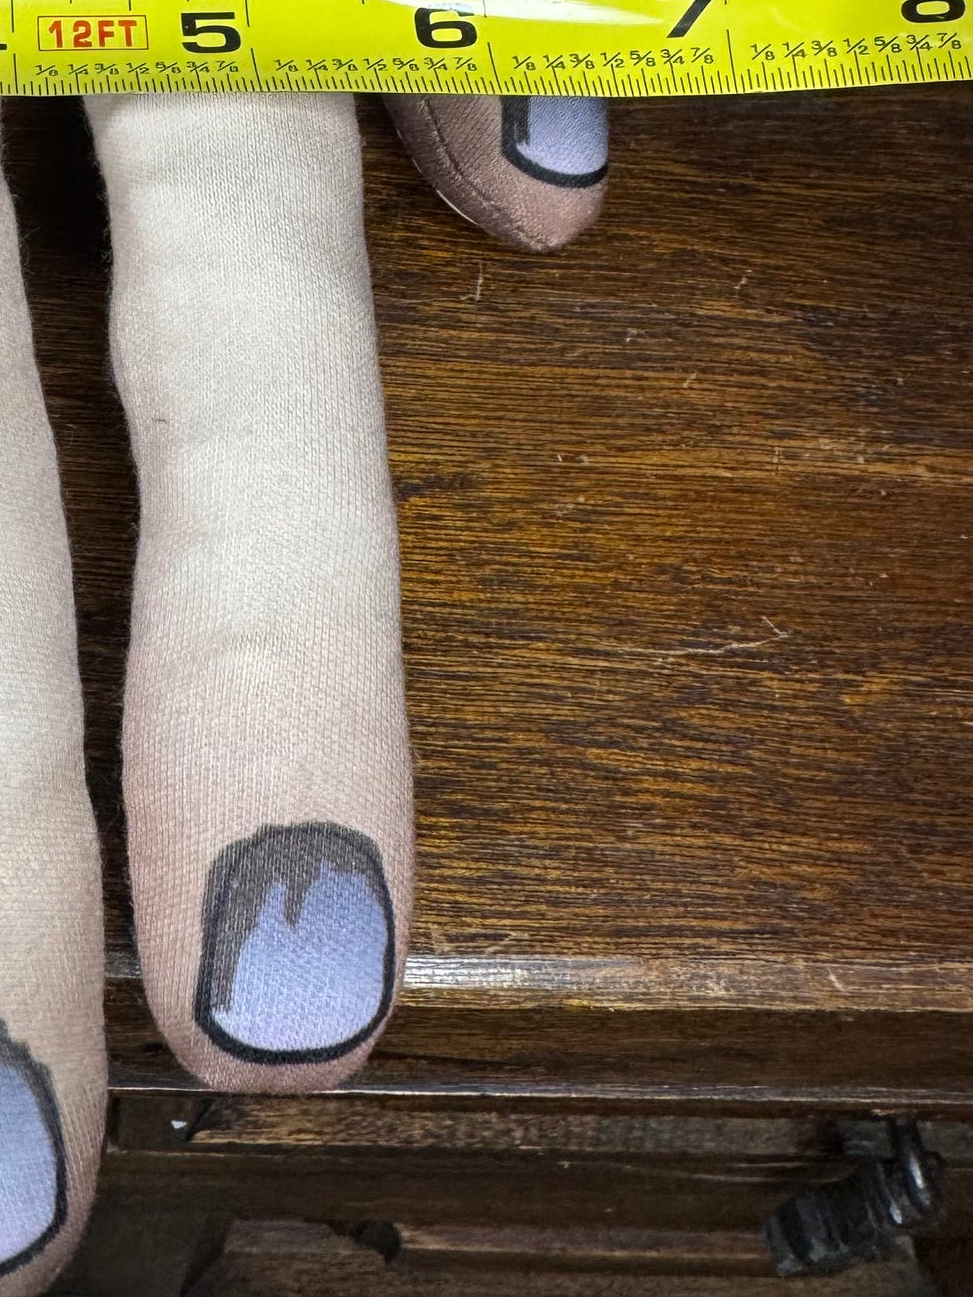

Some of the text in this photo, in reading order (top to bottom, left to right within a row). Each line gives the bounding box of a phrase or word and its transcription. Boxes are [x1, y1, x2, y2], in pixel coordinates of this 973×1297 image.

[181, 12, 242, 54] 5
[414, 6, 478, 49] 6
[751, 32, 962, 61] 1/8 1/4 3/8 1/2 5/8 3/4 7/8
